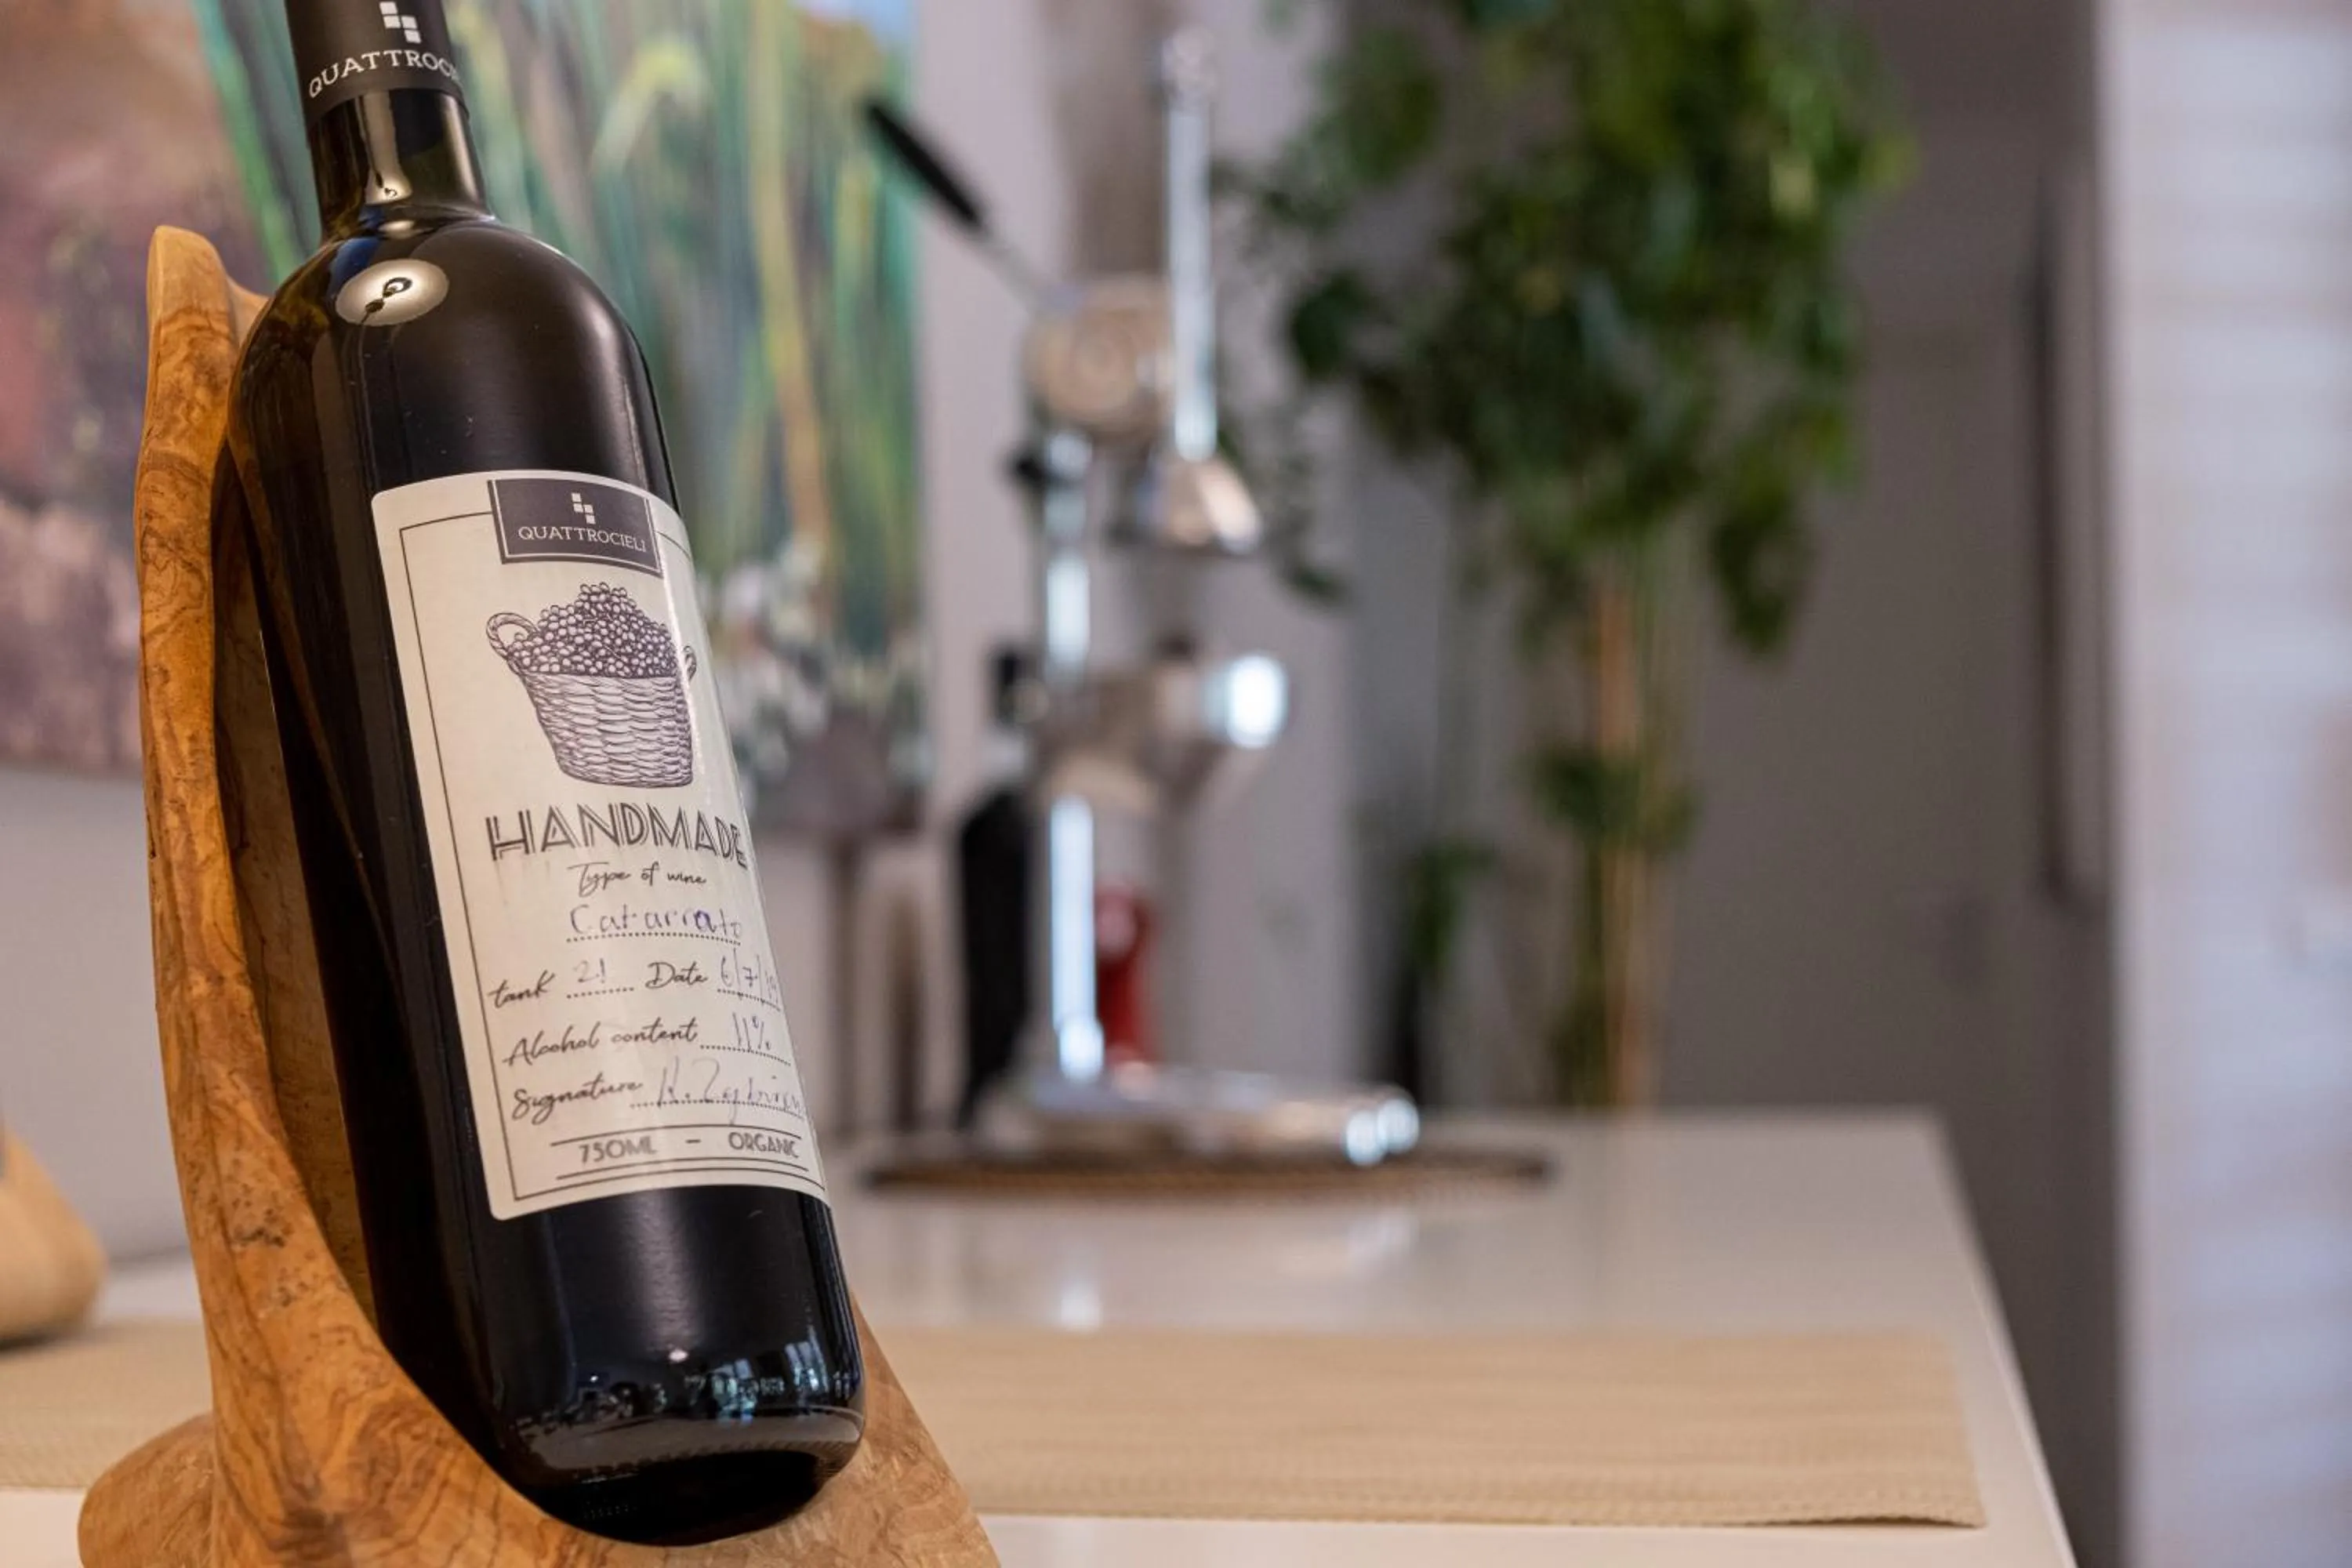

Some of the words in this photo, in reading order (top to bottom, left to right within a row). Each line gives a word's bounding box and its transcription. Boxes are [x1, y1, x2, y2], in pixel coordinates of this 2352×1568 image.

[309, 49, 461, 98] QUATTROC
[517, 525, 647, 553] QUATTROCIELI
[485, 802, 748, 869] HANDMADE
[567, 862, 632, 898] Type
[641, 862, 659, 886] of
[667, 873, 707, 886] wine
[488, 969, 555, 1009] tank
[645, 960, 709, 989] Date
[503, 1021, 600, 1067] Alcohol
[612, 1017, 699, 1044] content
[511, 1071, 644, 1125] Signature
[579, 1135, 658, 1163] 750ML
[728, 1131, 800, 1159] ORGANIC
